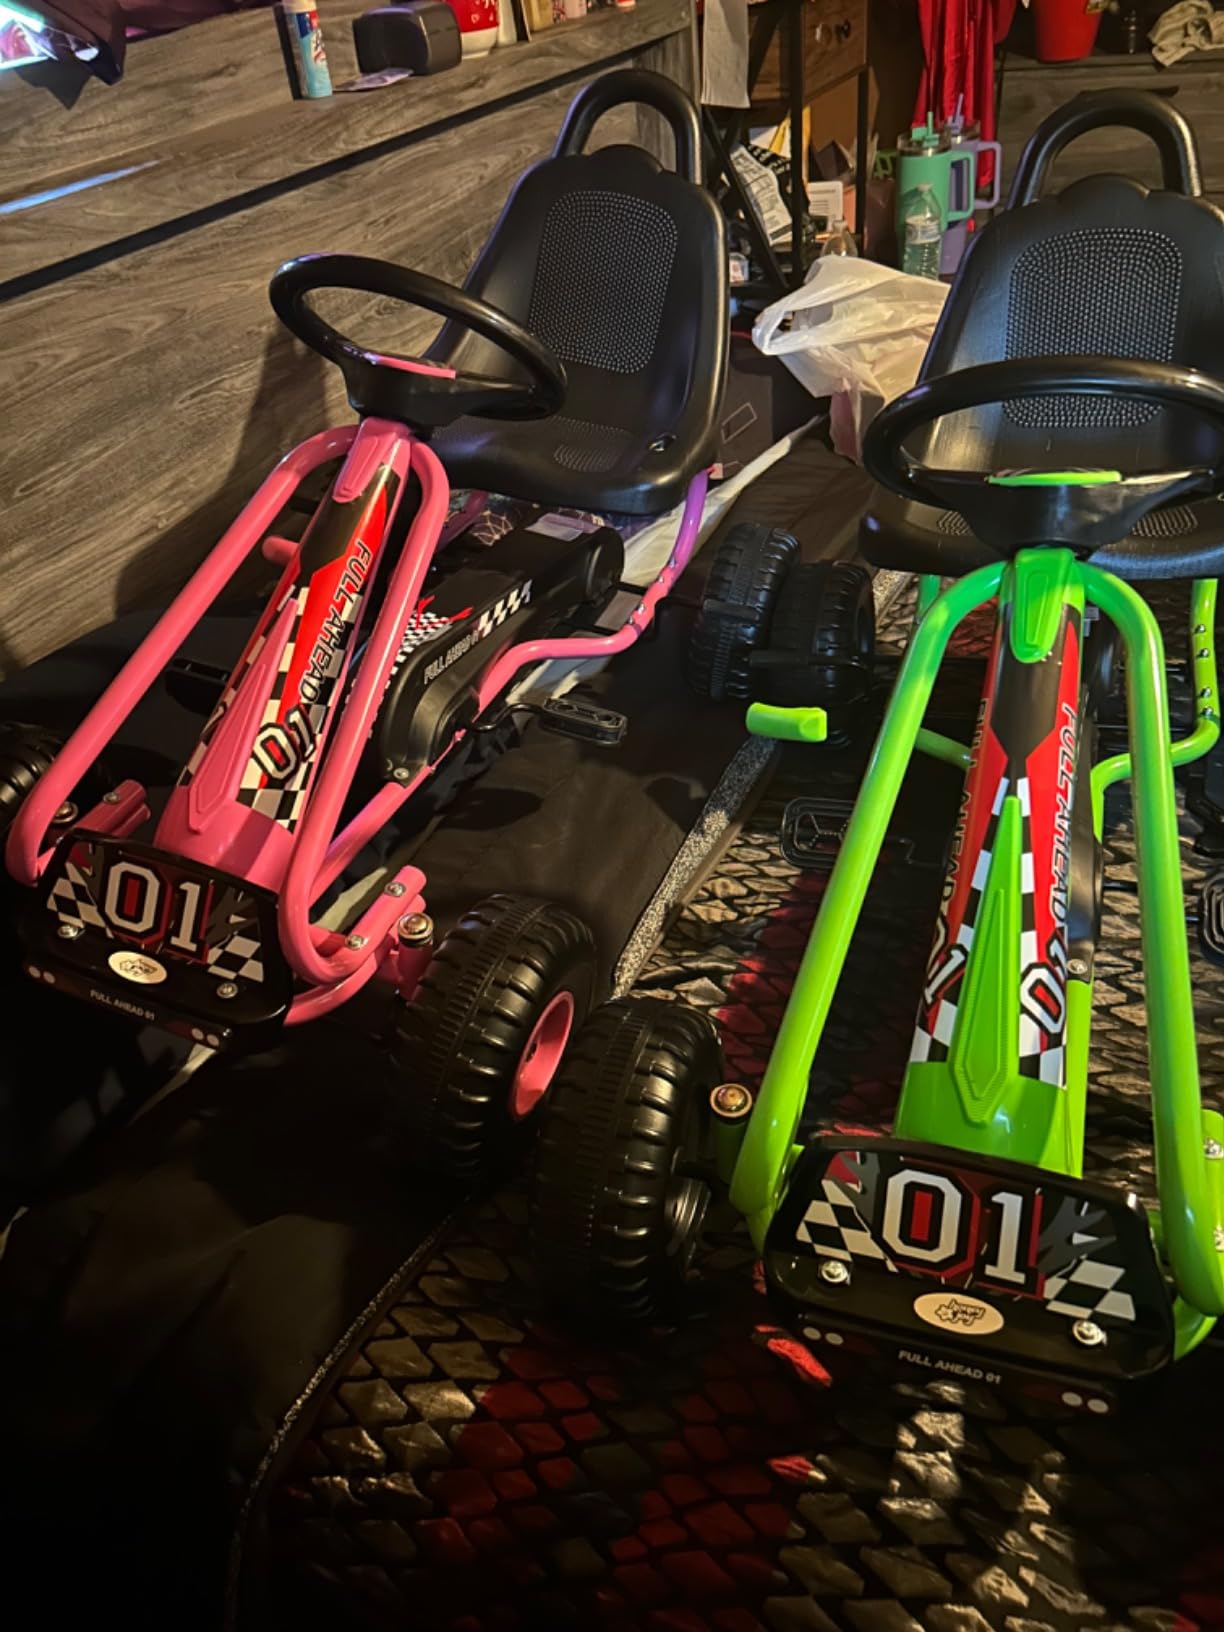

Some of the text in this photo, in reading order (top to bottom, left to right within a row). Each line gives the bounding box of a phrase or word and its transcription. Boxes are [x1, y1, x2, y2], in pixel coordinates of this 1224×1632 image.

[252, 537, 373, 780] FULL AHEAD 01
[1056, 702, 1077, 790] FULL
[1050, 794, 1072, 926] AHEAD
[104, 861, 202, 952] 01
[90, 989, 113, 1005] FULL
[114, 998, 145, 1017] AHEAD
[881, 1168, 1027, 1284] 01
[898, 1349, 1002, 1384] FULL AHEAD 01
